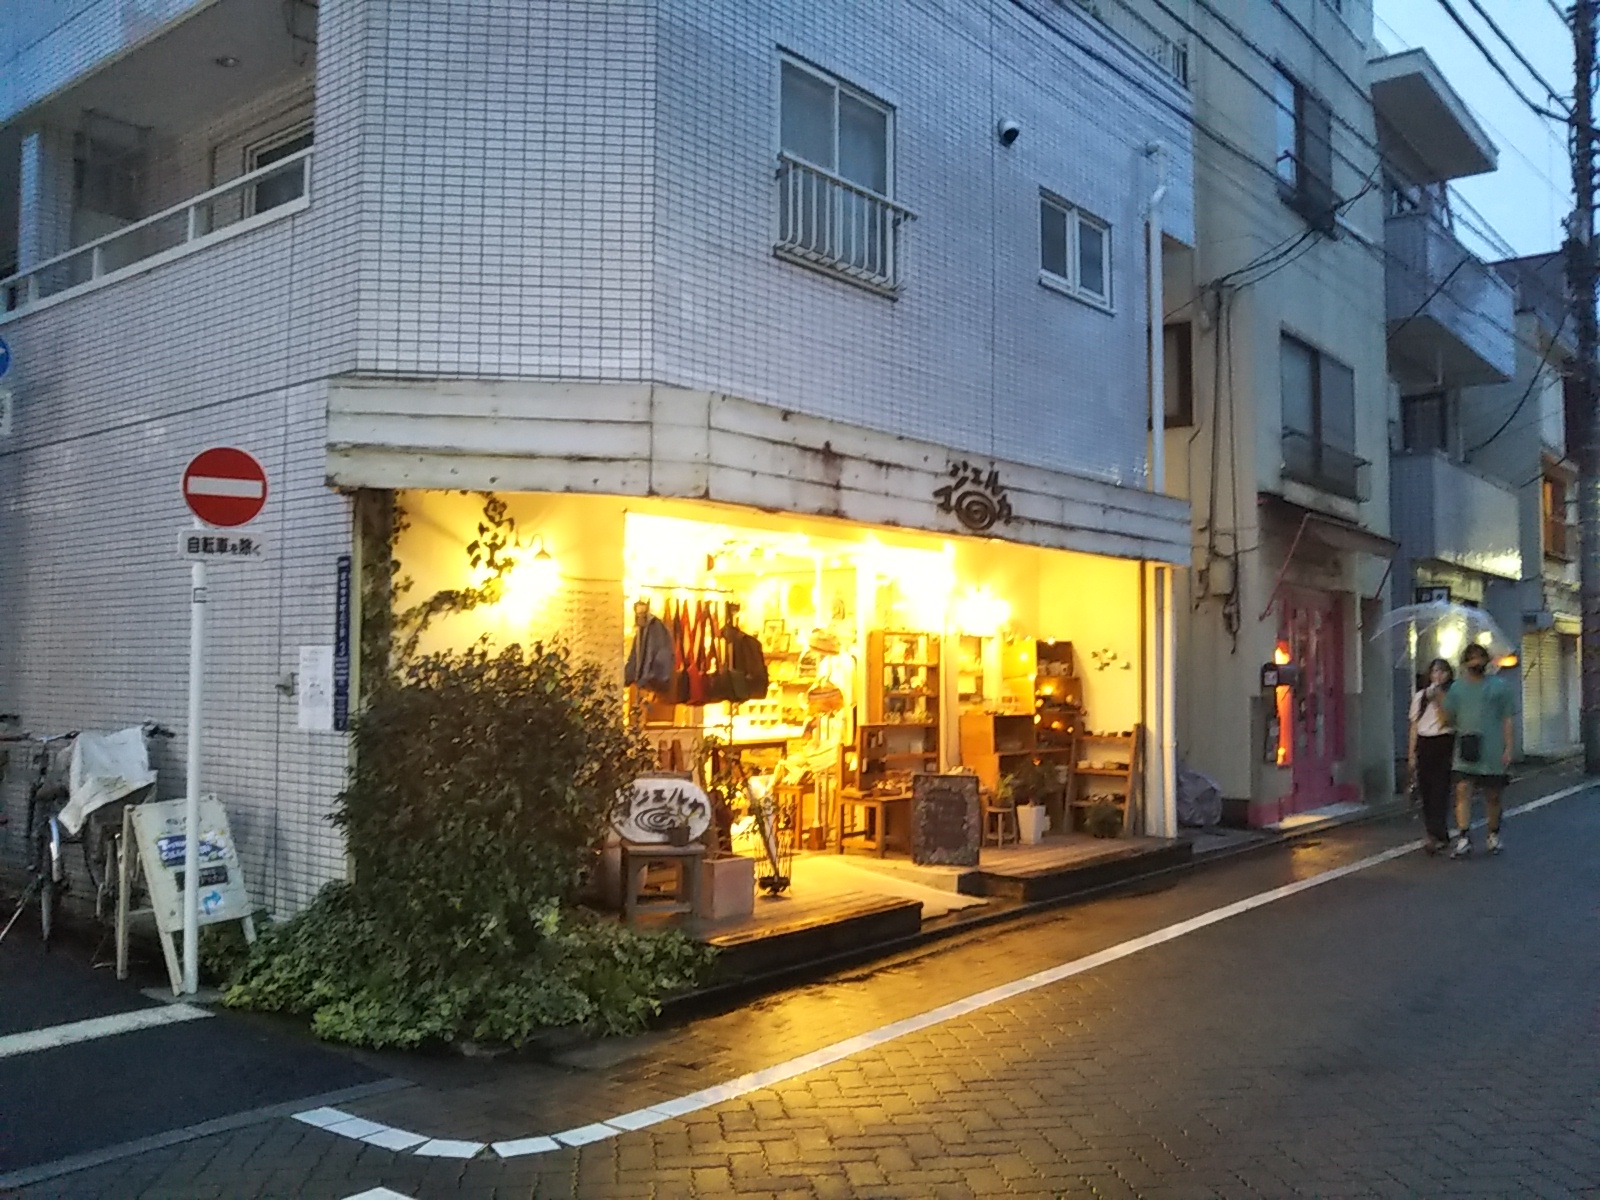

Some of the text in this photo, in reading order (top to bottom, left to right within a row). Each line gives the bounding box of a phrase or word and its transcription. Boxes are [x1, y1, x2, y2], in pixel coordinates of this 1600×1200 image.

[187, 536, 262, 557] 自転車を除く
